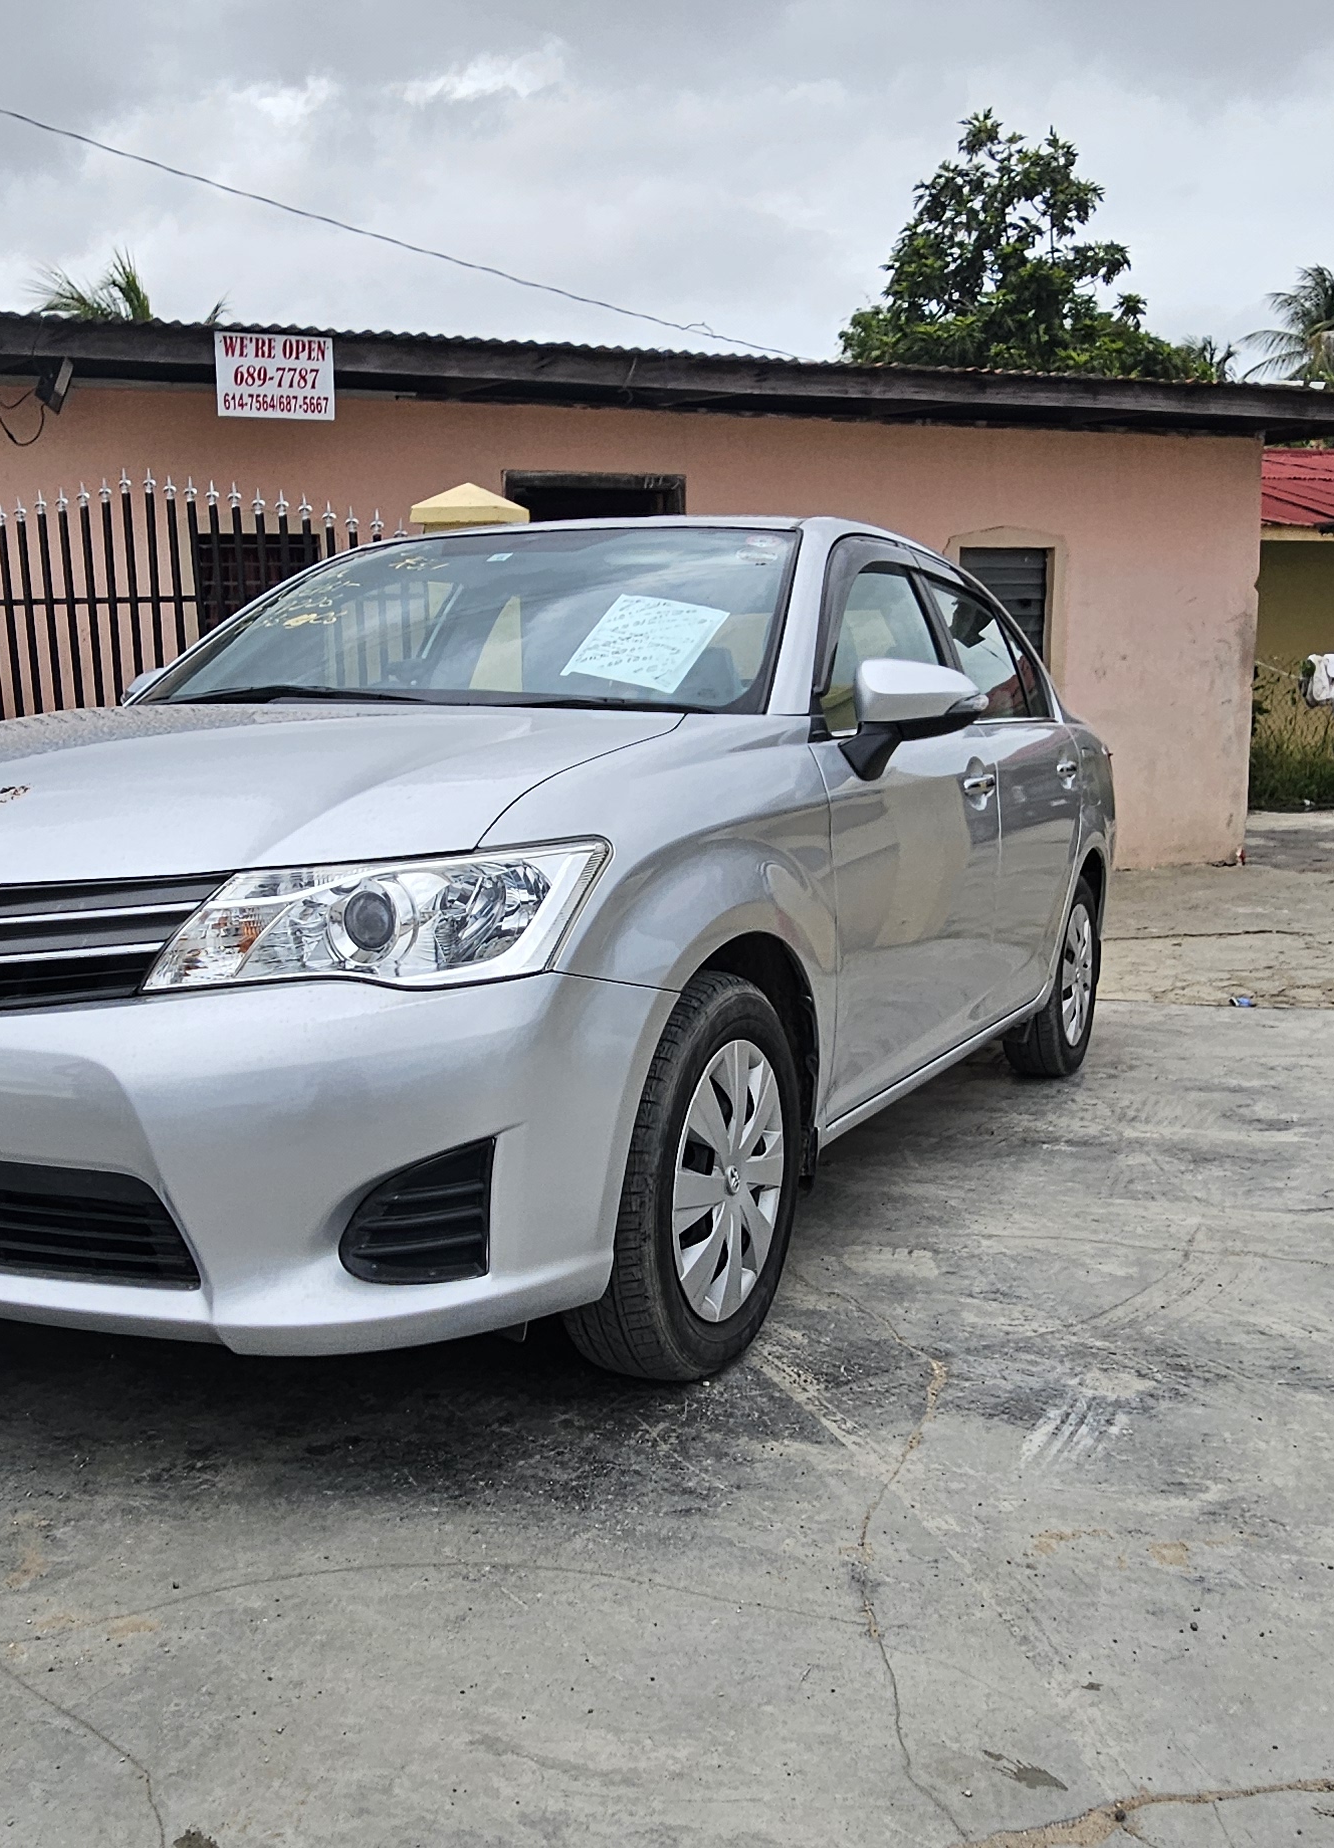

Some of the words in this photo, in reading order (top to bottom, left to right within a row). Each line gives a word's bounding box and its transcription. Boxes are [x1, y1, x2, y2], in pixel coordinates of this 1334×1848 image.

[223, 336, 276, 359] WE'RE
[282, 338, 327, 362] OPEN
[234, 365, 320, 389] 689-7787
[224, 392, 329, 414] 614-7564/687-5667
